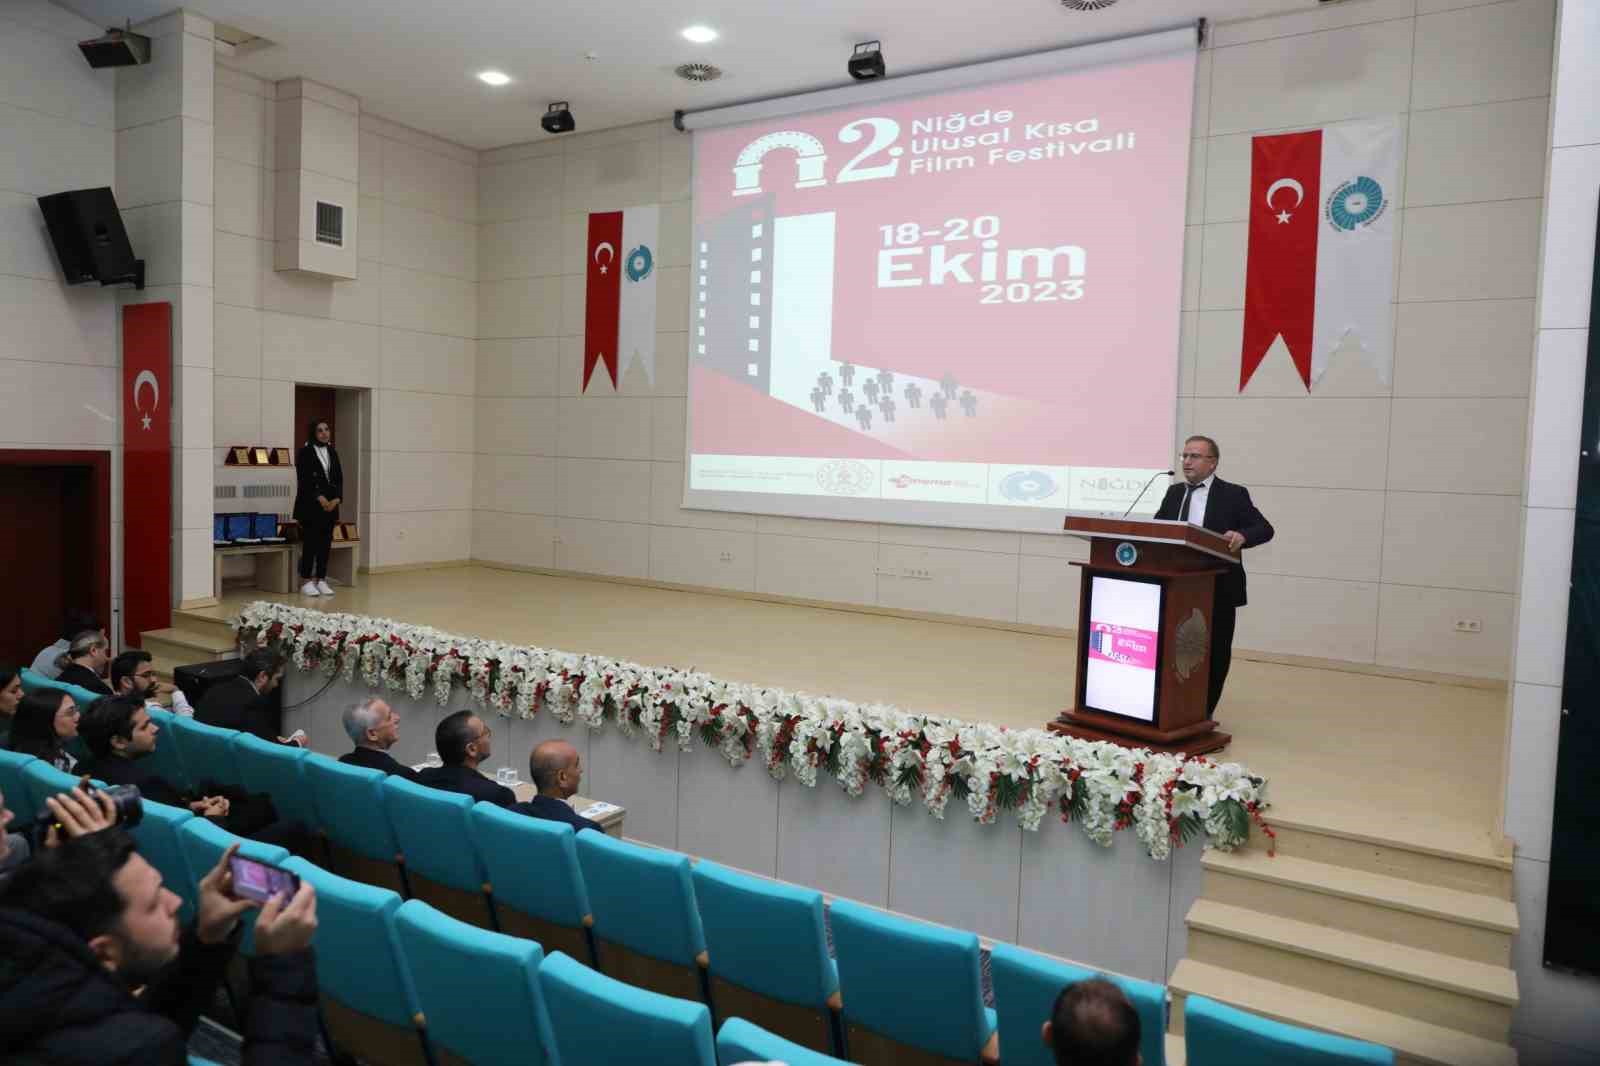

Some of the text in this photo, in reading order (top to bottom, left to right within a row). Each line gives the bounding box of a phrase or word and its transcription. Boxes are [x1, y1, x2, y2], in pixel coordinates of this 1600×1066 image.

[909, 131, 1136, 176] Film Festivali
[911, 117, 1099, 155] Ulusal Kısa
[879, 215, 1000, 247] 18-20
[877, 239, 1087, 288] Ekim
[979, 279, 1085, 304] 2023
